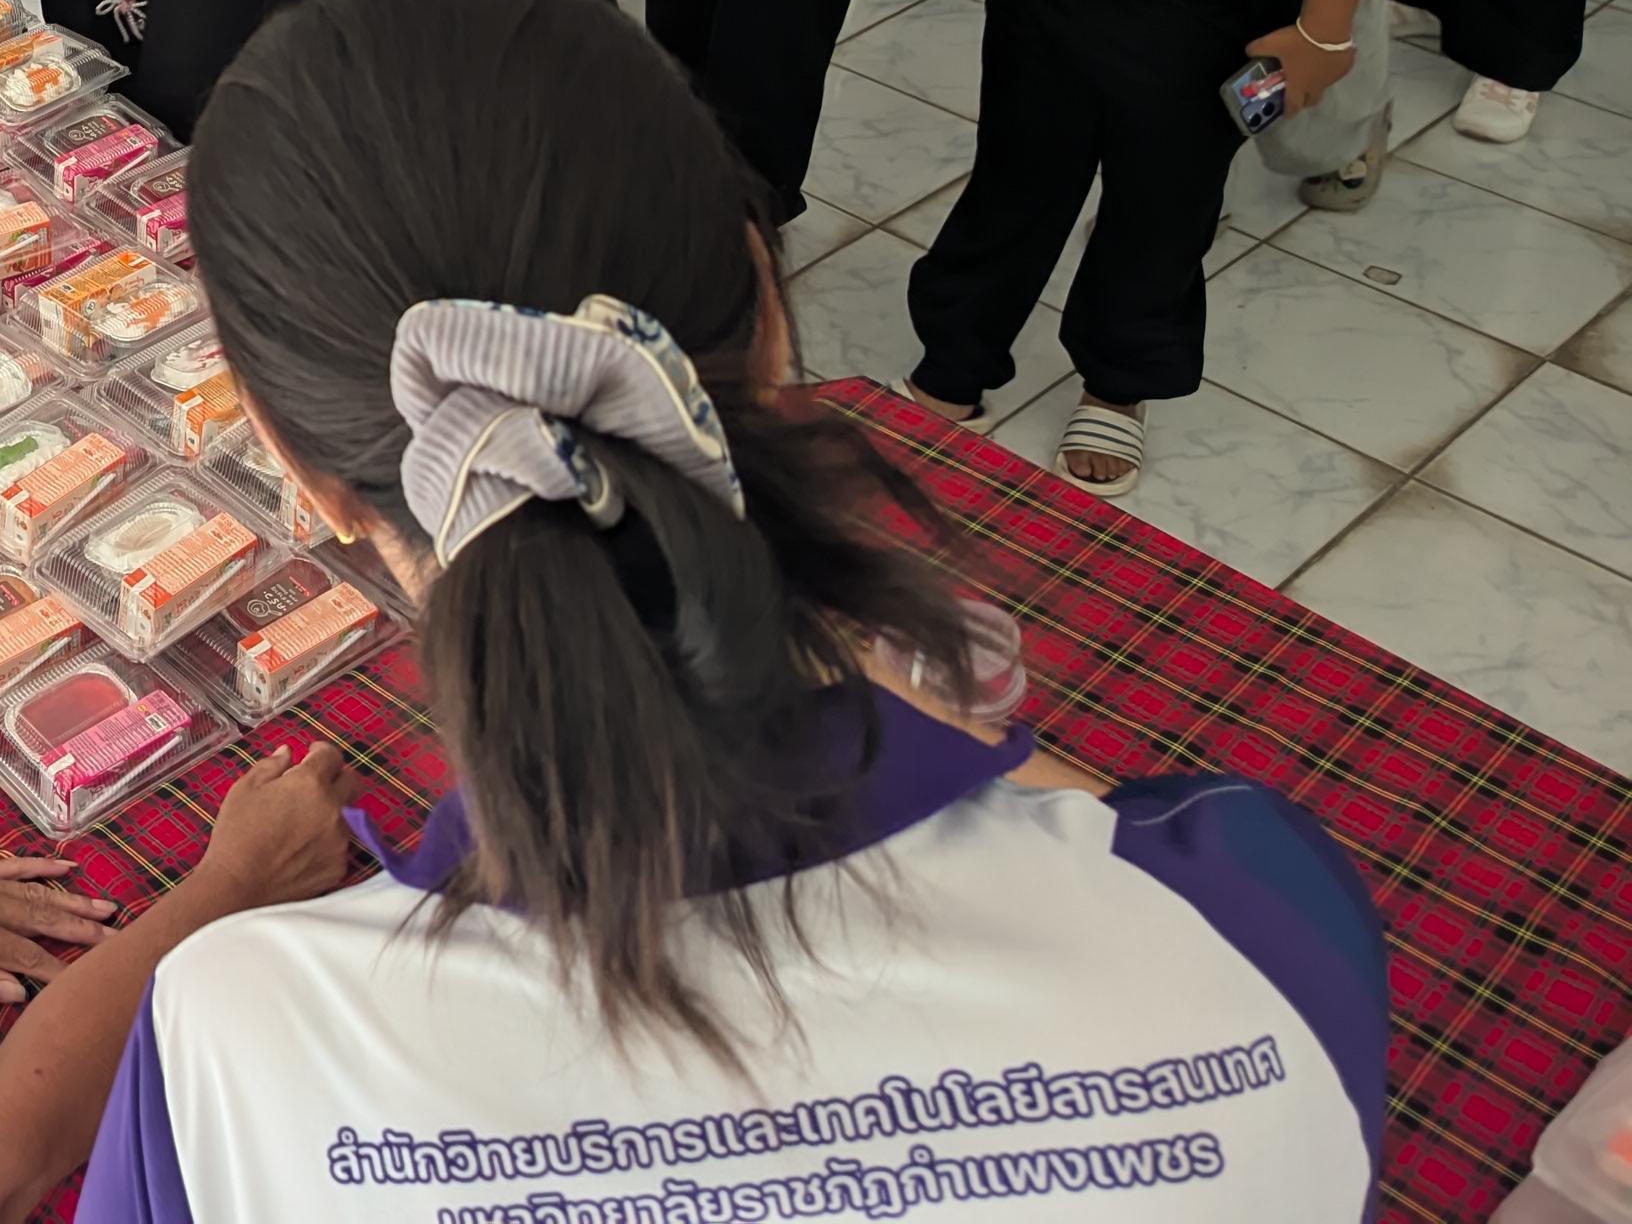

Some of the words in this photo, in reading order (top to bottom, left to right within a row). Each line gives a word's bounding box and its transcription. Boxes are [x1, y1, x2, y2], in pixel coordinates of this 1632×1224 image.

[327, 1033, 1287, 1185] สำนักวิทยบริการและเทคโนโลยีสารสนเทศ
